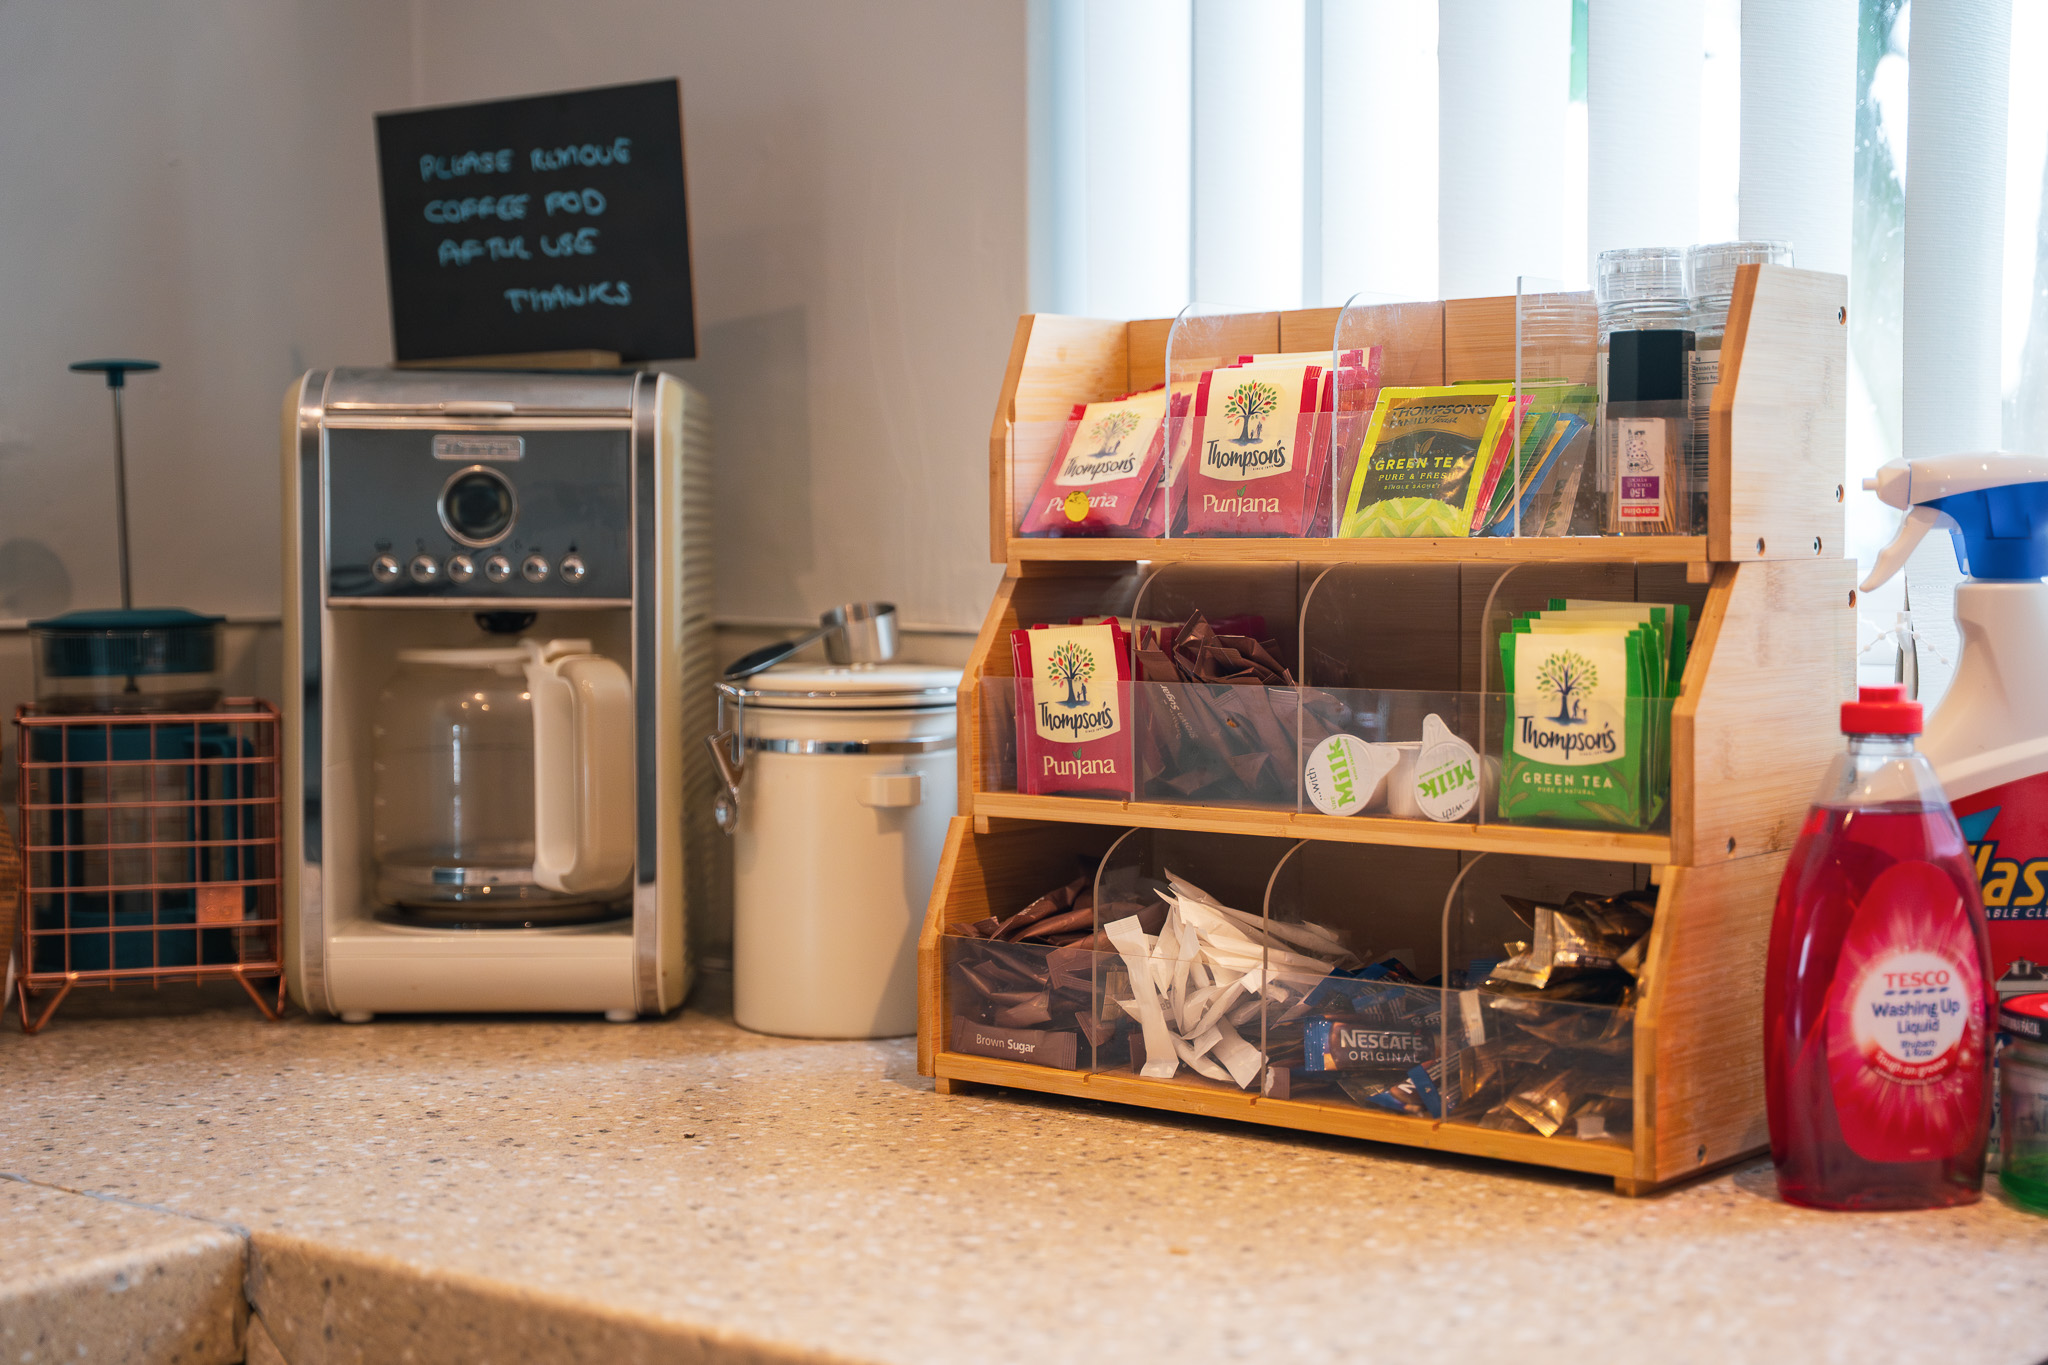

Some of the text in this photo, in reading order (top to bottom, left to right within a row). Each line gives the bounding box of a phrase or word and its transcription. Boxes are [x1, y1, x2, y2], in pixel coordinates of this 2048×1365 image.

[420, 136, 632, 182] PLEASE REMOVE
[424, 188, 607, 224] COFFEE POD
[437, 227, 600, 267] AFTER USE
[503, 281, 632, 313] THANKS
[1392, 404, 1490, 417] THOMPSON'S
[1389, 416, 1431, 428] FAMILY
[1064, 453, 1136, 481] Thompson's
[1207, 439, 1286, 476] Thompson's
[1375, 457, 1428, 471] GREEN
[1378, 473, 1405, 481] PURE
[1629, 488, 1646, 497] 150
[1044, 494, 1119, 515] Puana
[1203, 494, 1279, 517] Punjana
[1624, 507, 1657, 515] caroline
[1038, 701, 1114, 738] Thompson's
[1518, 716, 1616, 760] Thompson's
[1043, 755, 1116, 779] Punjana
[1326, 737, 1356, 807] Milk
[1418, 759, 1476, 799] Milk
[1522, 772, 1613, 788] GREEN TEA
[1968, 844, 2048, 907] las
[1986, 908, 2020, 918] ABLE
[1884, 970, 1949, 989] TESCO
[1871, 999, 1960, 1018] Washing Up
[1897, 1019, 1939, 1035] Liquid
[976, 1033, 1036, 1054] Brown Sugar
[1349, 1051, 1420, 1063] ORIGINAL
